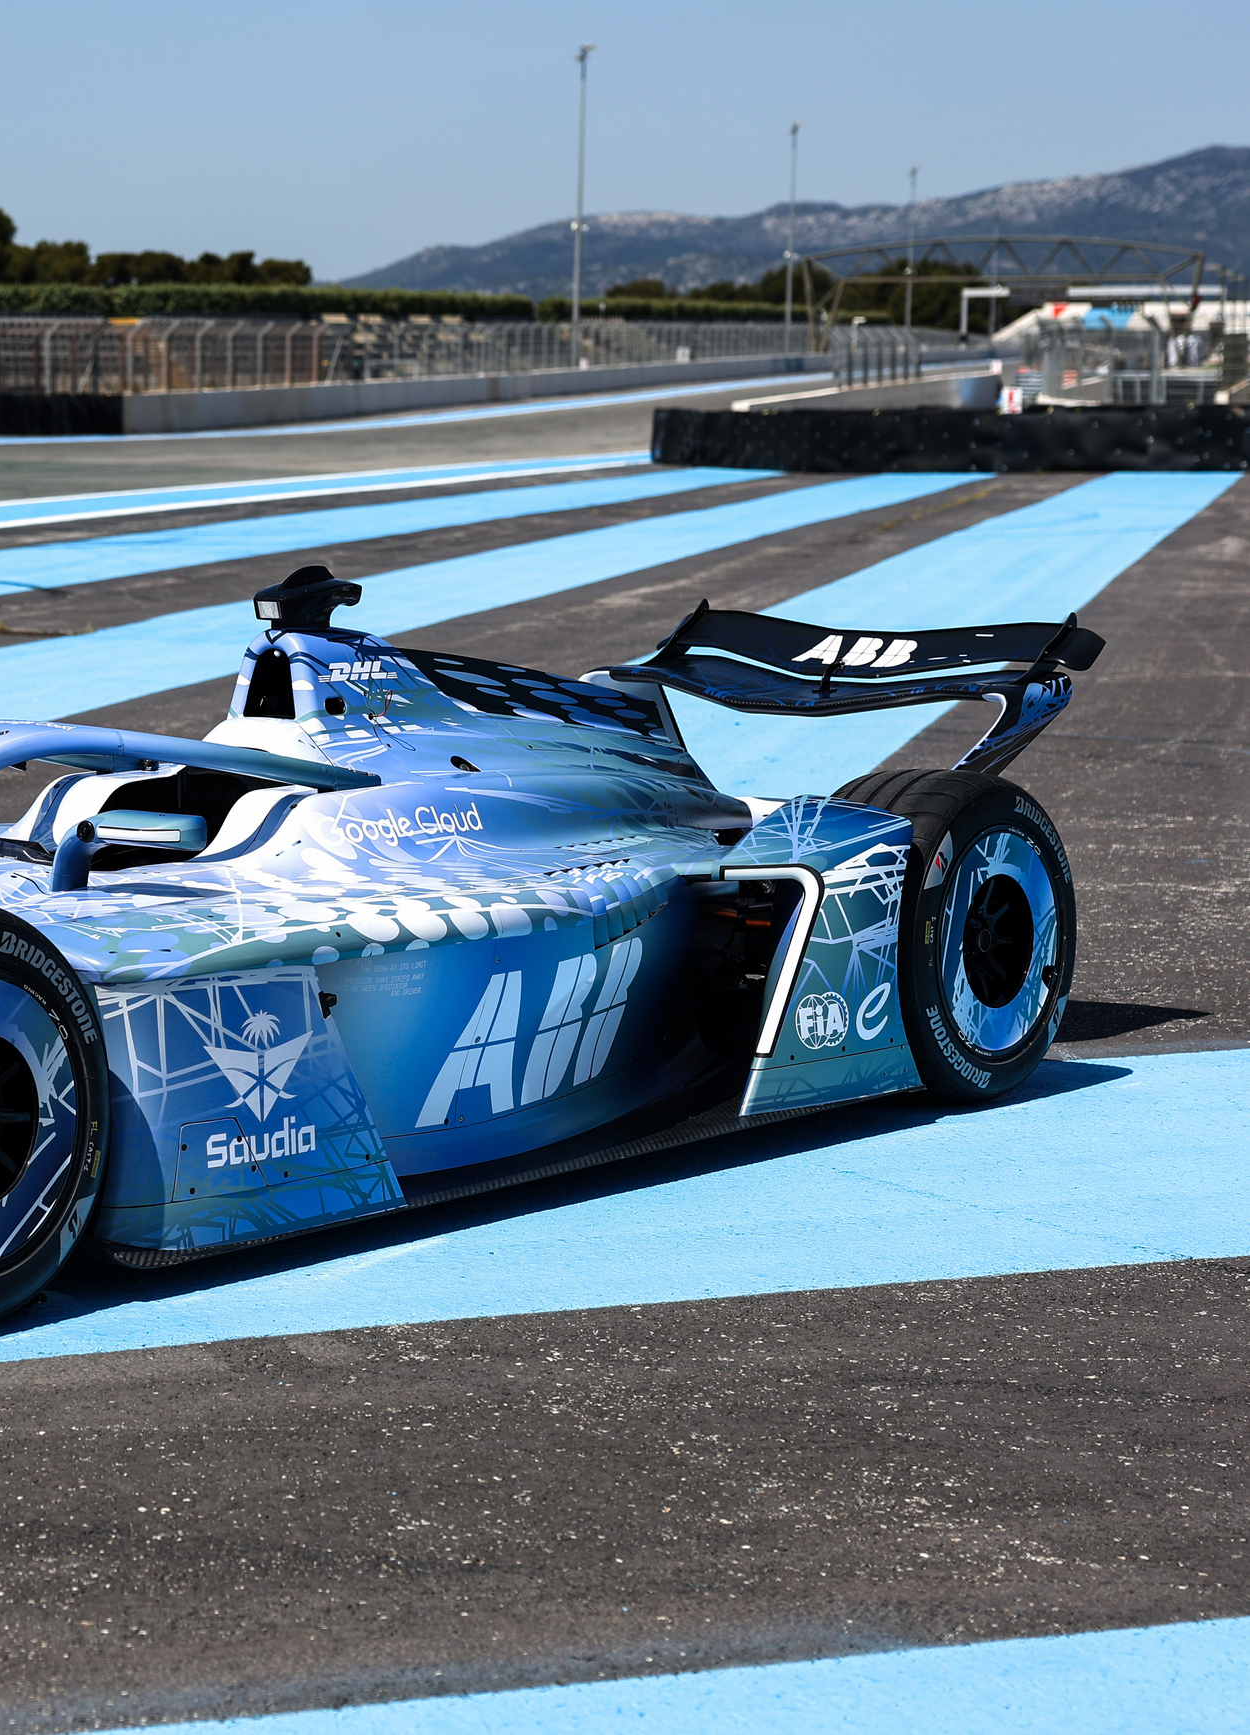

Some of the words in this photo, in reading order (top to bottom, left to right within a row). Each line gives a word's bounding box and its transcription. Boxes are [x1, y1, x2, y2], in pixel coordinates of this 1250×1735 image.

[790, 634, 918, 668] ABB
[328, 660, 387, 682] DHL
[315, 808, 415, 847] Google
[414, 802, 485, 835] Cloud
[1014, 795, 1071, 883] BRIDGESTONE
[339, 976, 372, 985] IMMERSION
[375, 976, 388, 984] THAT
[391, 974, 411, 983] STRIPS
[411, 972, 425, 980] AWAY
[361, 965, 371, 973] THE
[390, 964, 398, 972] AT
[400, 962, 410, 971] ITS
[411, 960, 427, 969] LIMIT
[351, 983, 377, 992] BETWEEN
[379, 982, 408, 992] SPECTATOR
[390, 989, 400, 997] AND
[414, 937, 643, 1128] ABB
[926, 1004, 992, 1089] BRIDGESTONE
[206, 1115, 316, 1169] Saudia
